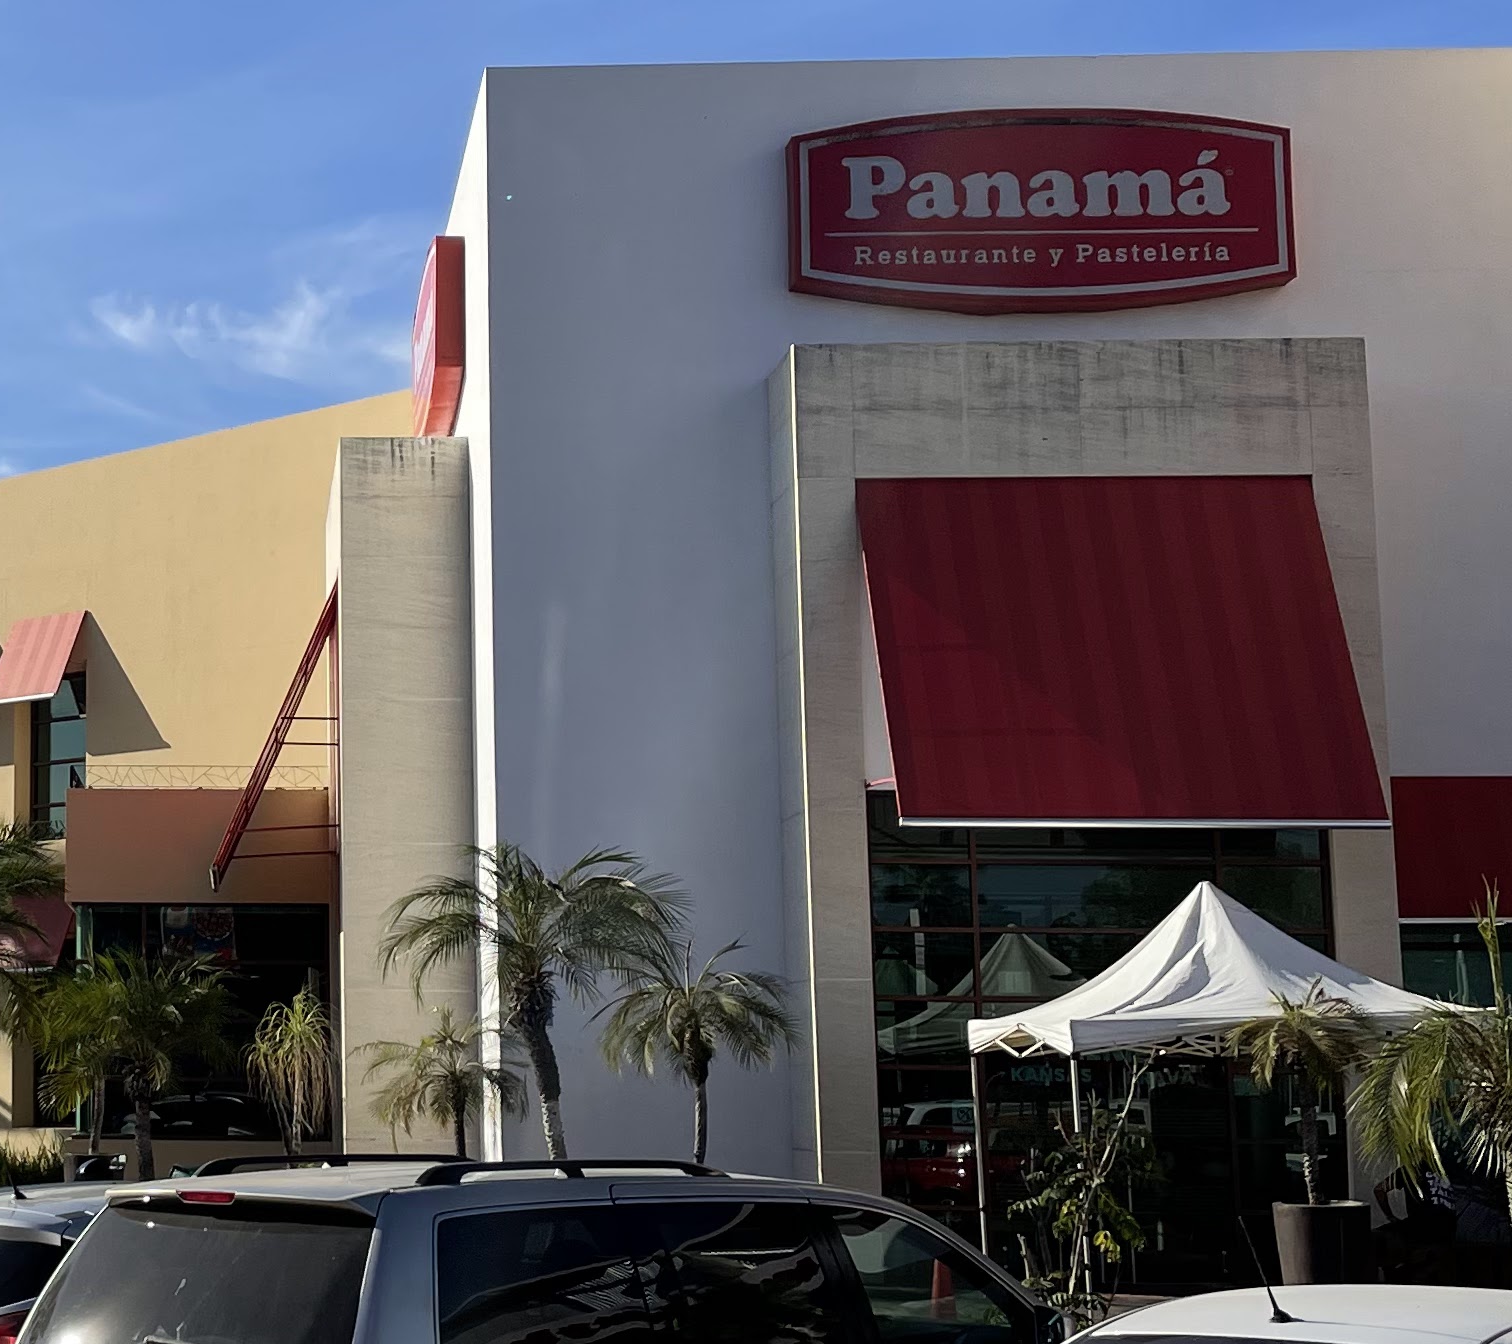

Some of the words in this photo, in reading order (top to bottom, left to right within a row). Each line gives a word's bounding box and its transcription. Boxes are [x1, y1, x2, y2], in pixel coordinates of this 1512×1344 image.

[841, 149, 1232, 220] Panamá
[854, 245, 1037, 266] Restaurante
[1049, 247, 1065, 267] y
[1076, 241, 1231, 264] Pastelería
